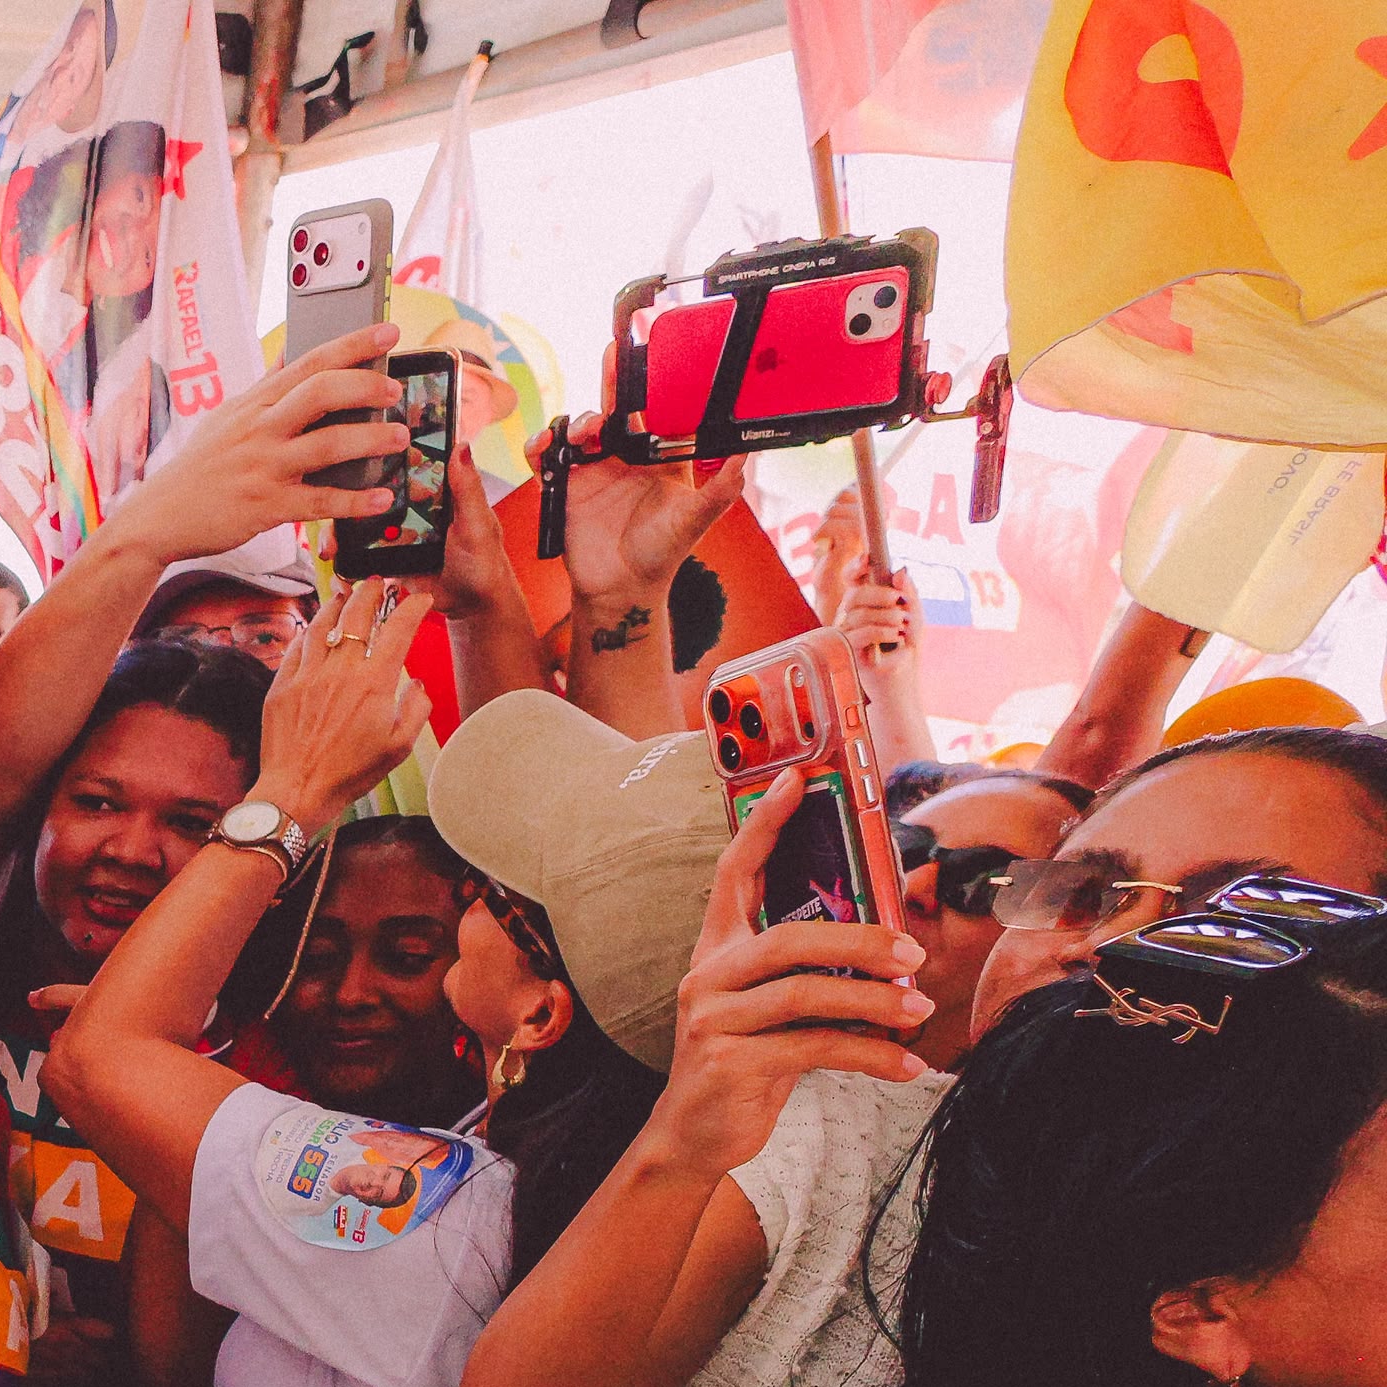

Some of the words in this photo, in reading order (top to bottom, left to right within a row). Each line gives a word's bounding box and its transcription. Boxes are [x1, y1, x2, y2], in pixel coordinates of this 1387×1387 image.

[172, 260, 204, 360] RAFAEL
[168, 351, 225, 418] 13
[292, 1149, 325, 1194] 555
[314, 1154, 339, 1202] SENADOR
